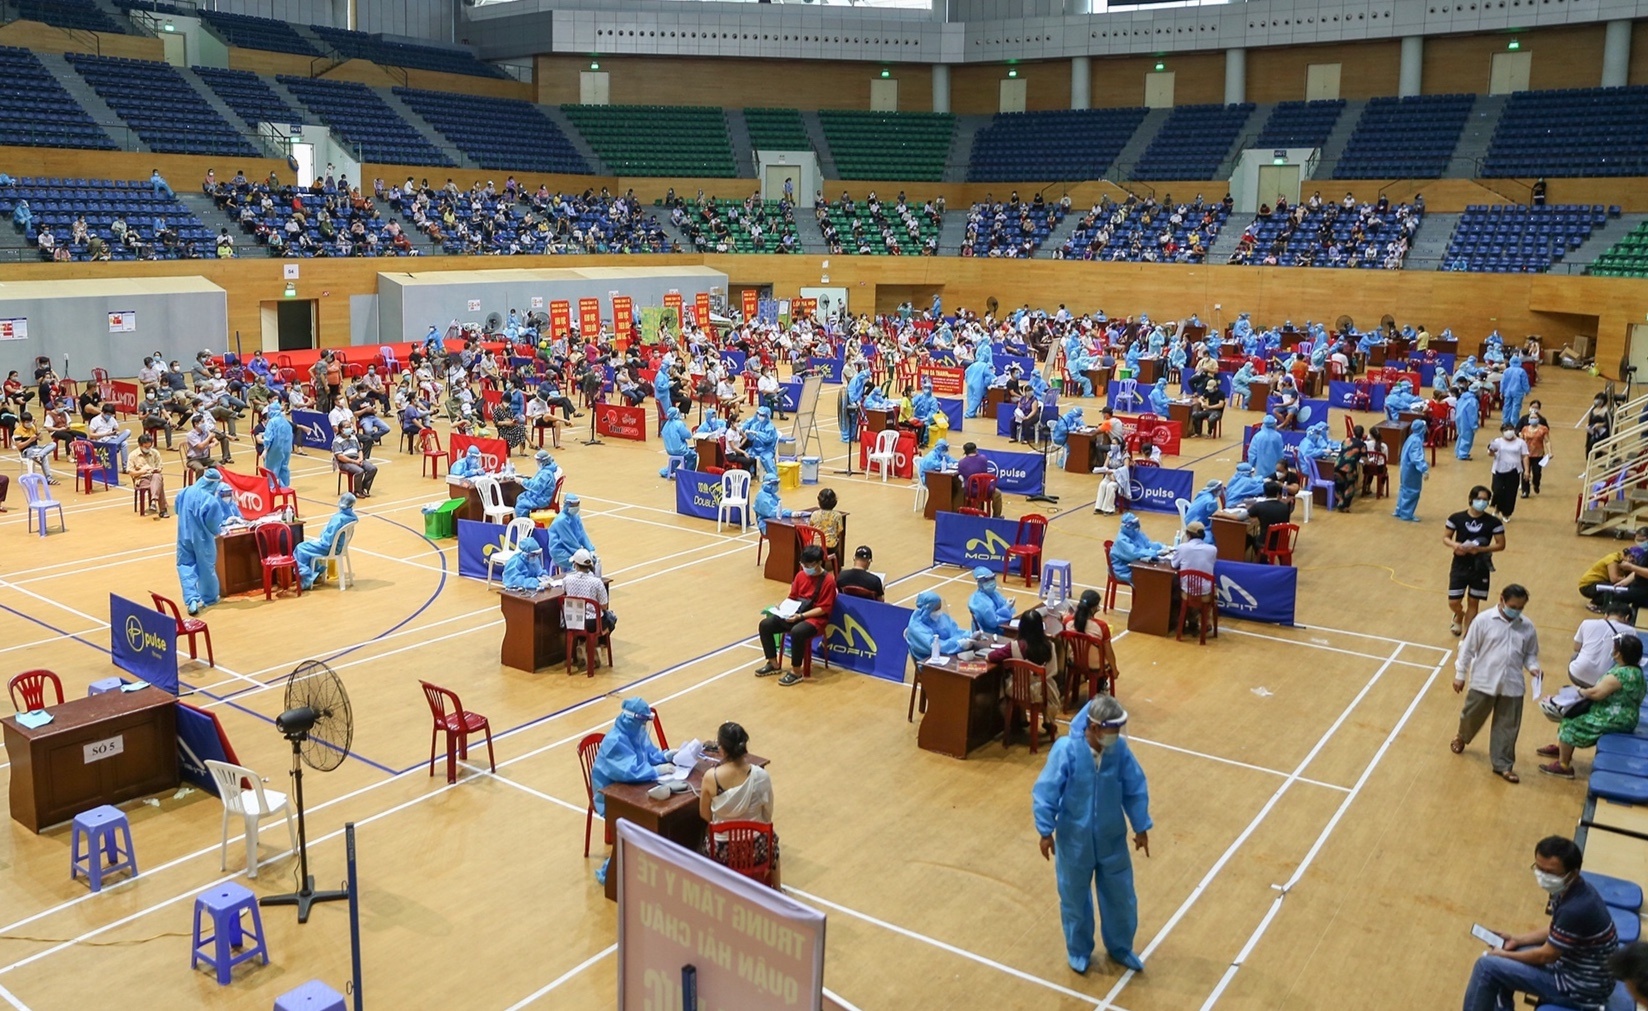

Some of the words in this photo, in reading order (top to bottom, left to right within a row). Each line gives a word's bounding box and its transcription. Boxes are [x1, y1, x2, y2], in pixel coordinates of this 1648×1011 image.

[1000, 468, 1026, 479] pulse
[1145, 487, 1175, 498] pulse
[693, 495, 716, 508] DOUBLE
[145, 632, 167, 651] pulse
[109, 742, 115, 751] 5
